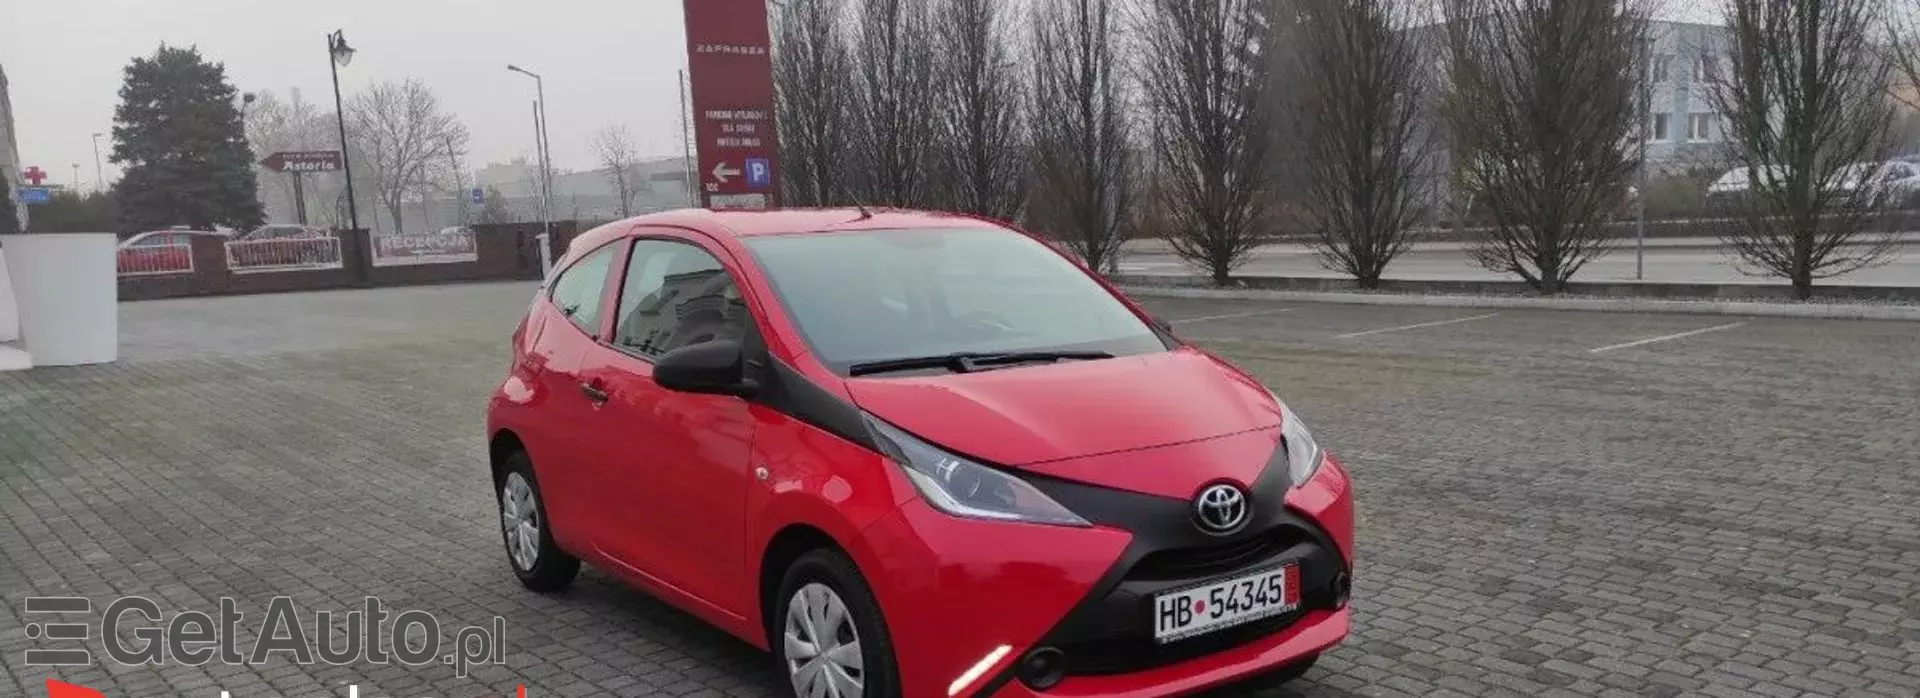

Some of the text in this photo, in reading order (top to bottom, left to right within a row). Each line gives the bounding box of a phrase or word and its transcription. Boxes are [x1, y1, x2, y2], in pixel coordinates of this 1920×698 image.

[282, 160, 335, 171] Astoria
[752, 162, 764, 181] P
[1160, 595, 1193, 632] HB
[1210, 574, 1282, 619] 54345
